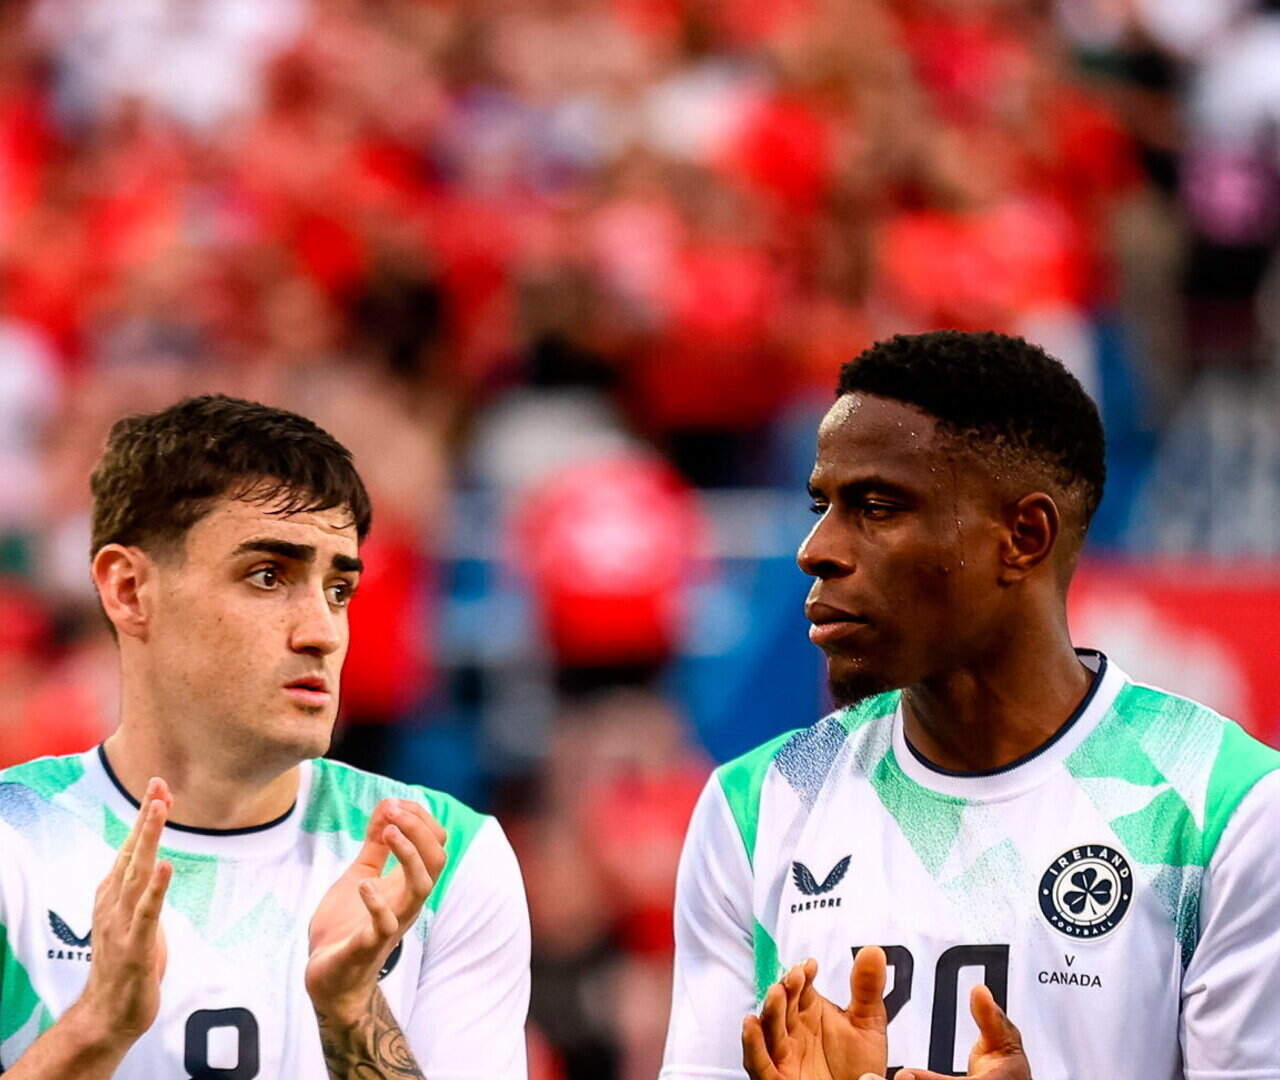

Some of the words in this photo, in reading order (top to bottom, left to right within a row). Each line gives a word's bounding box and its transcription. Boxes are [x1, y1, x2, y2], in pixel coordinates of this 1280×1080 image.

[1049, 846, 1130, 878] IRELAND
[790, 898, 842, 914] CASTORE
[1051, 915, 1114, 936] FOOTBALL
[47, 949, 92, 962] CASTO
[1064, 954, 1076, 967] V
[1038, 971, 1102, 988] CANADA
